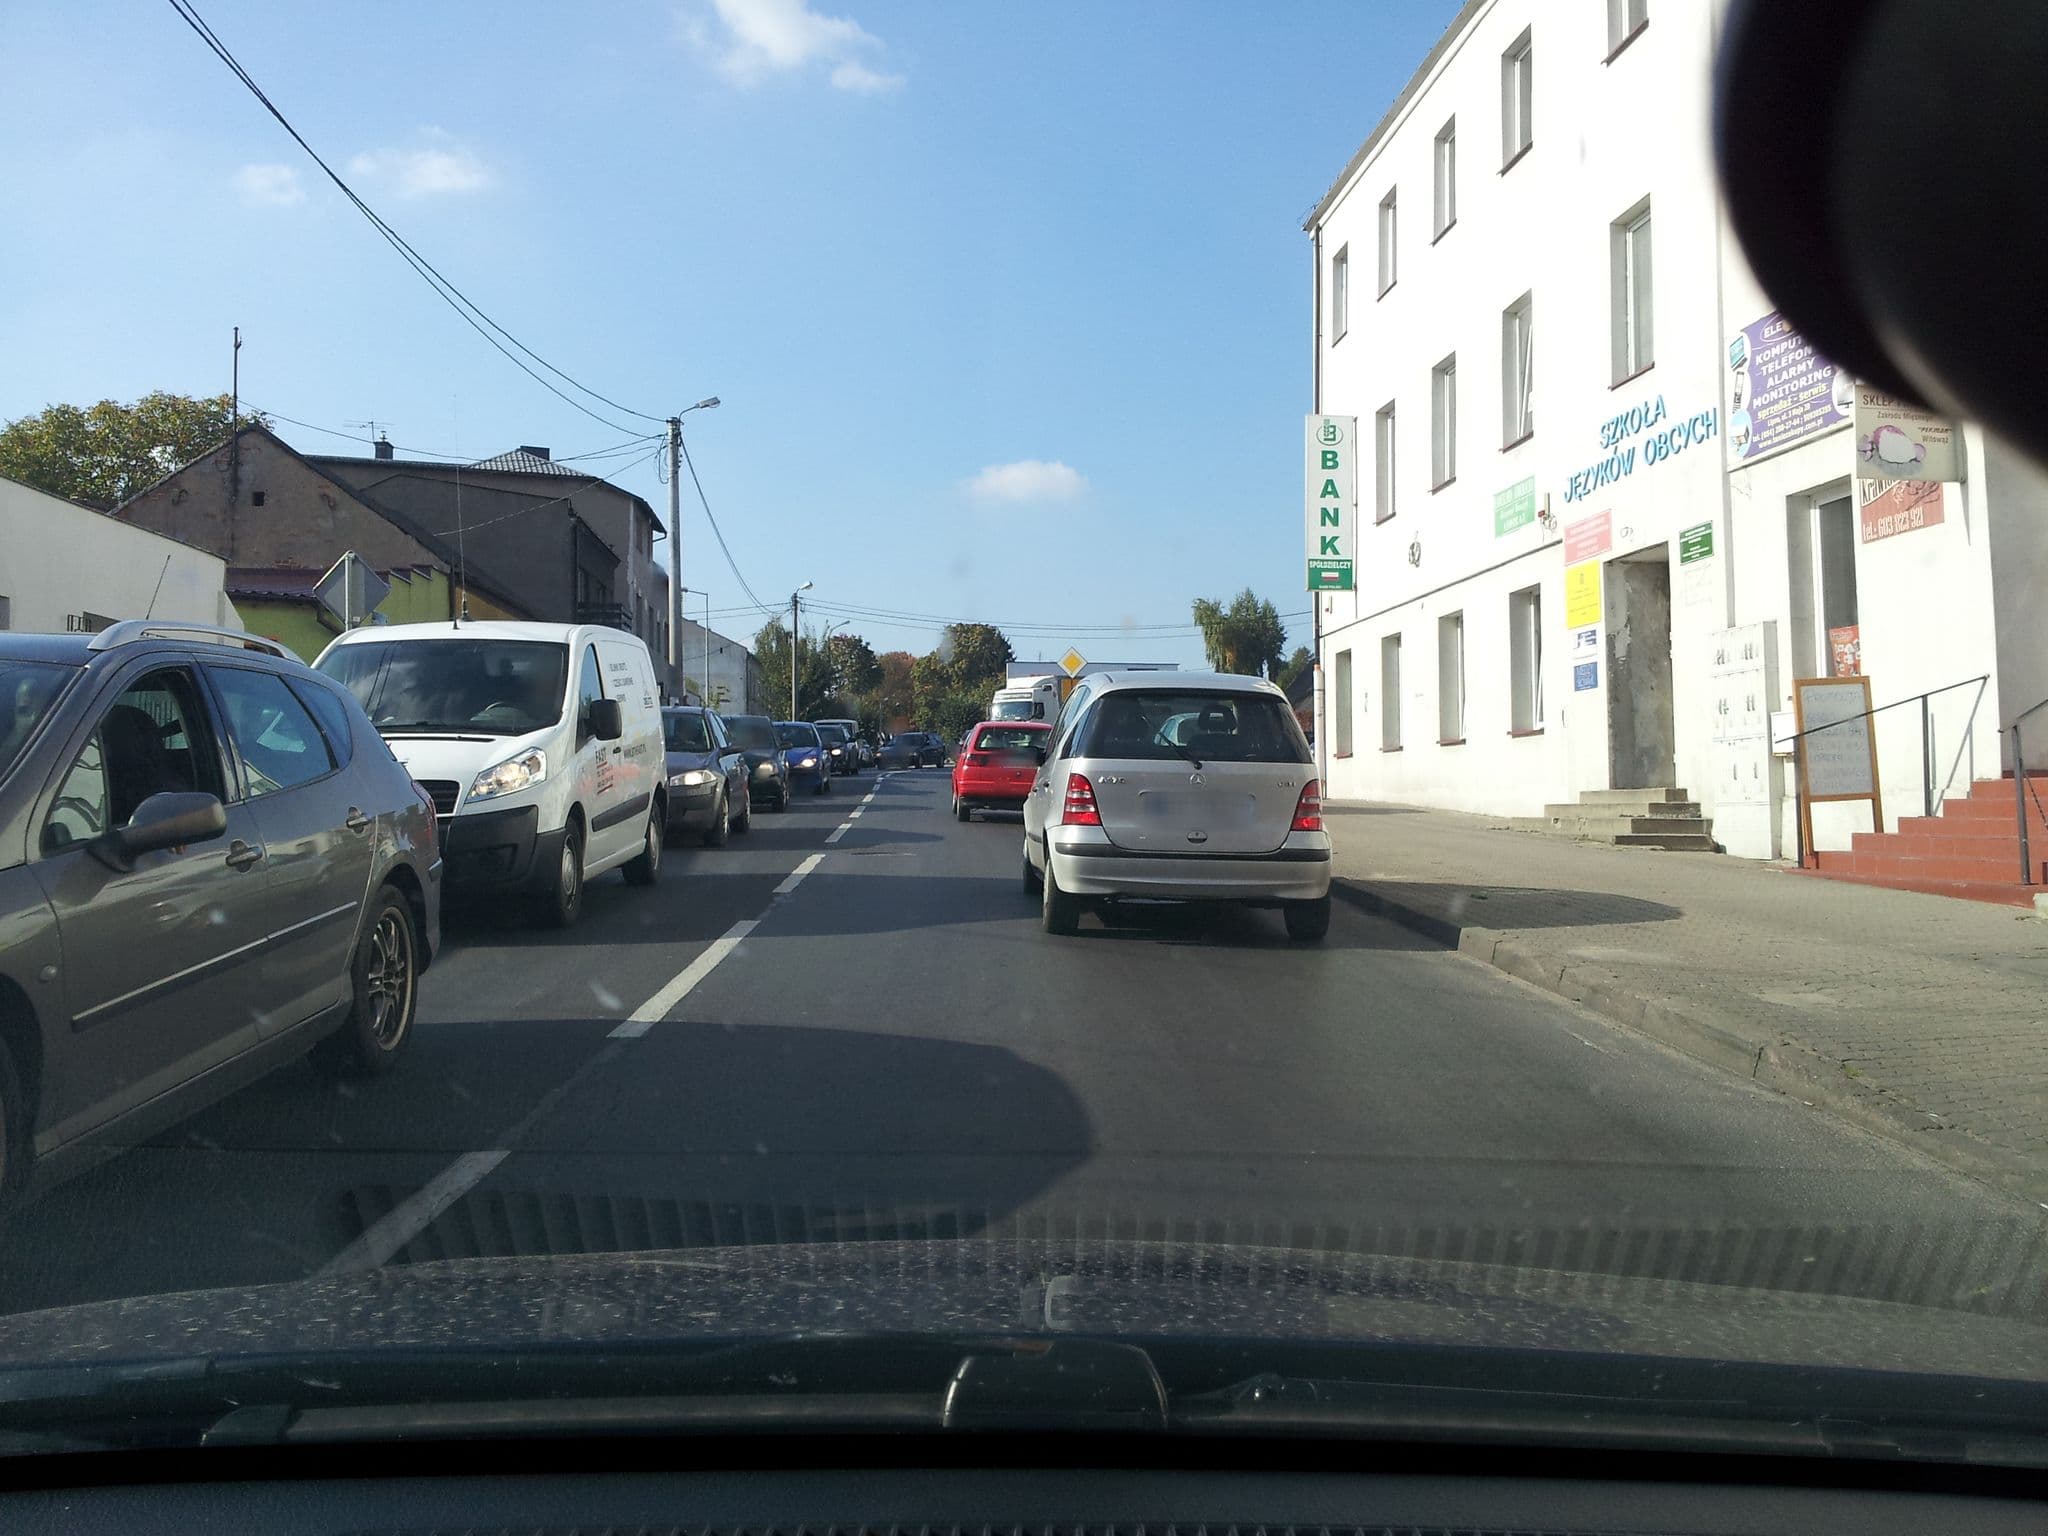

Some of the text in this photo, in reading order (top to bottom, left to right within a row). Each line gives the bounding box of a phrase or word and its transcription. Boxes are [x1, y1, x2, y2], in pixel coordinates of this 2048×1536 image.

[1753, 366, 1832, 409] MONITORING
[1767, 356, 1816, 388] ALARMY
[1600, 394, 1667, 449] SZKOŁA
[1564, 446, 1636, 504] JĘZYKÓW
[1645, 407, 1717, 466] OBCYCH
[1320, 450, 1341, 556] BANK
